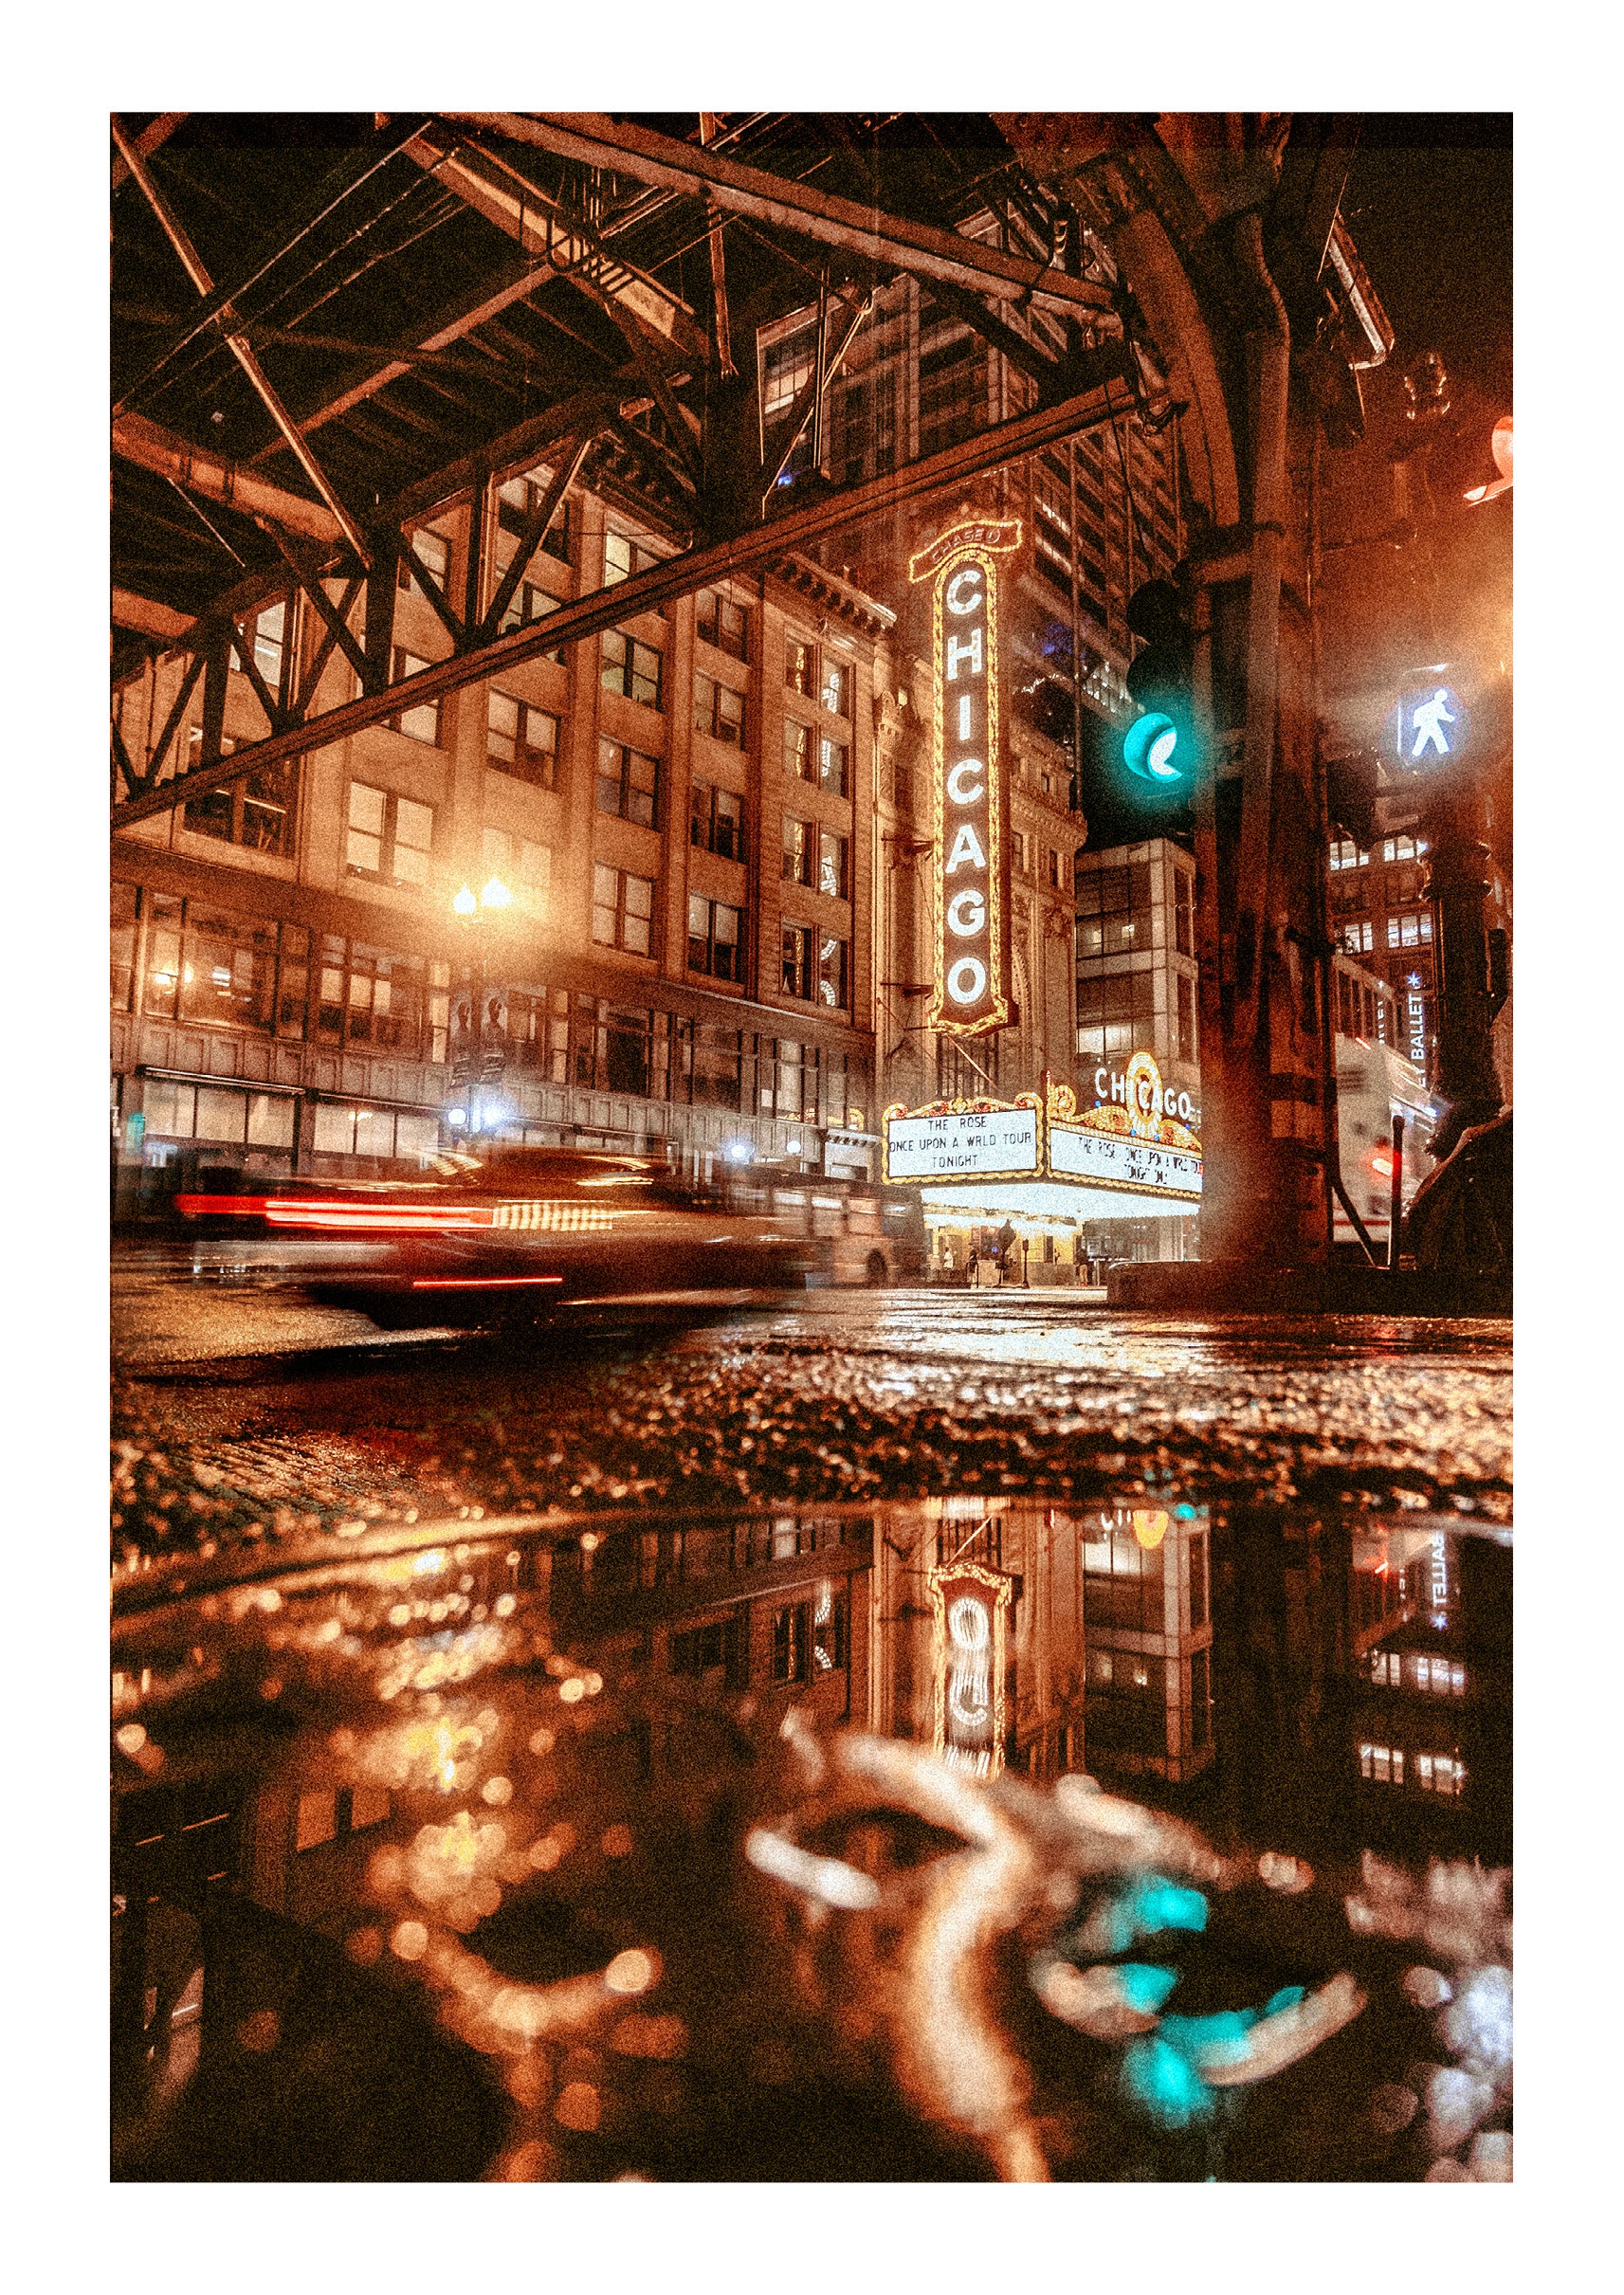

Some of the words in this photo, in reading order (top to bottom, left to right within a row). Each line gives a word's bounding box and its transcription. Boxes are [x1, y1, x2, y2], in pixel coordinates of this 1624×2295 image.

[930, 528, 985, 564] CHASE
[946, 569, 987, 1005] CHICAGO
[1409, 993, 1425, 1060] BALLET
[1094, 1067, 1192, 1120] CHICAGO
[927, 1119, 949, 1131] THE
[959, 1116, 988, 1129] ROSE
[889, 1139, 914, 1153] ONCE
[919, 1137, 947, 1151] UPON
[952, 1137, 959, 1148] A
[967, 1134, 997, 1148] WRLD
[1003, 1131, 1032, 1145] TOUR
[932, 1155, 979, 1169] TONIGHT
